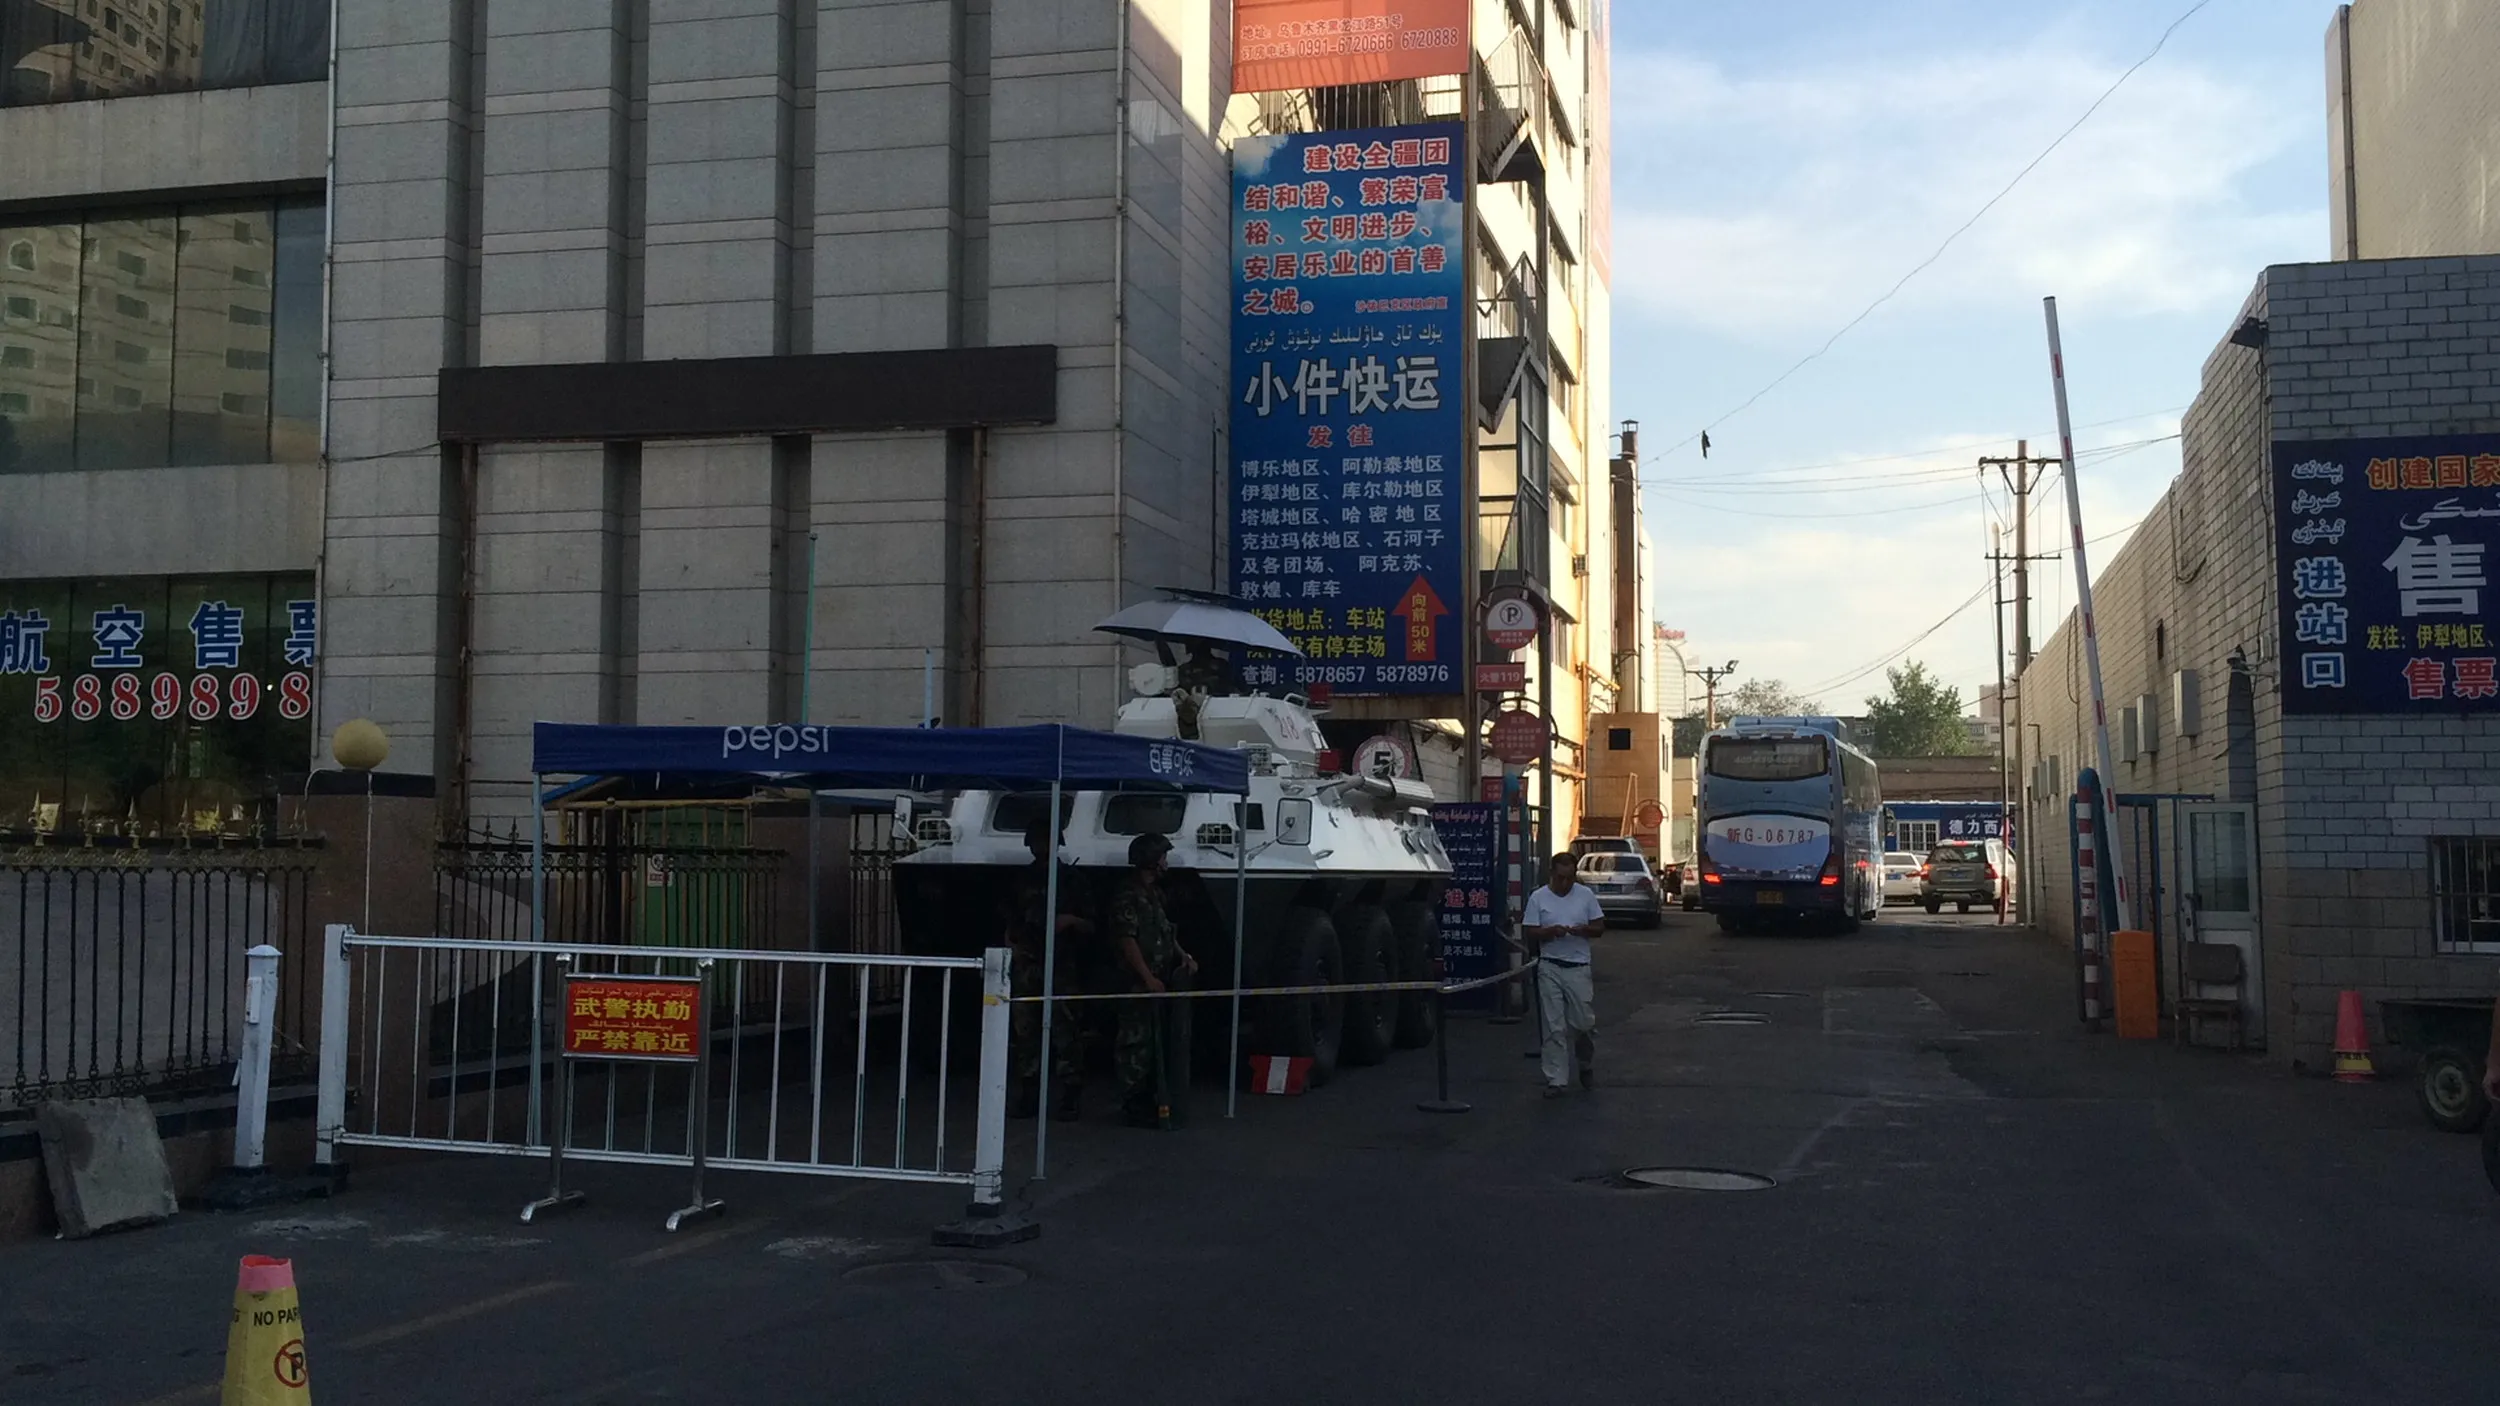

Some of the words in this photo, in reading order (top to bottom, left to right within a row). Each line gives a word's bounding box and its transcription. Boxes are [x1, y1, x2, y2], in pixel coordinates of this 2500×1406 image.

[1400, 28, 1459, 49] 6720888
[1303, 138, 1449, 172] 建设全疆团
[1243, 246, 1446, 281] 安居乐业的首善
[1243, 355, 1440, 417] 小件快运
[1306, 424, 1374, 448] 发往
[2365, 453, 2500, 490] 创建国家
[1411, 593, 1430, 653] 向前50米
[2293, 556, 2348, 689] 进站口
[1375, 665, 1449, 682] 5878976
[2402, 657, 2498, 700] 售票
[722, 725, 831, 759] pepsi
[573, 997, 691, 1021] 武警执勤
[573, 1028, 690, 1052] 严禁靠近
[254, 1310, 274, 1326] NO
